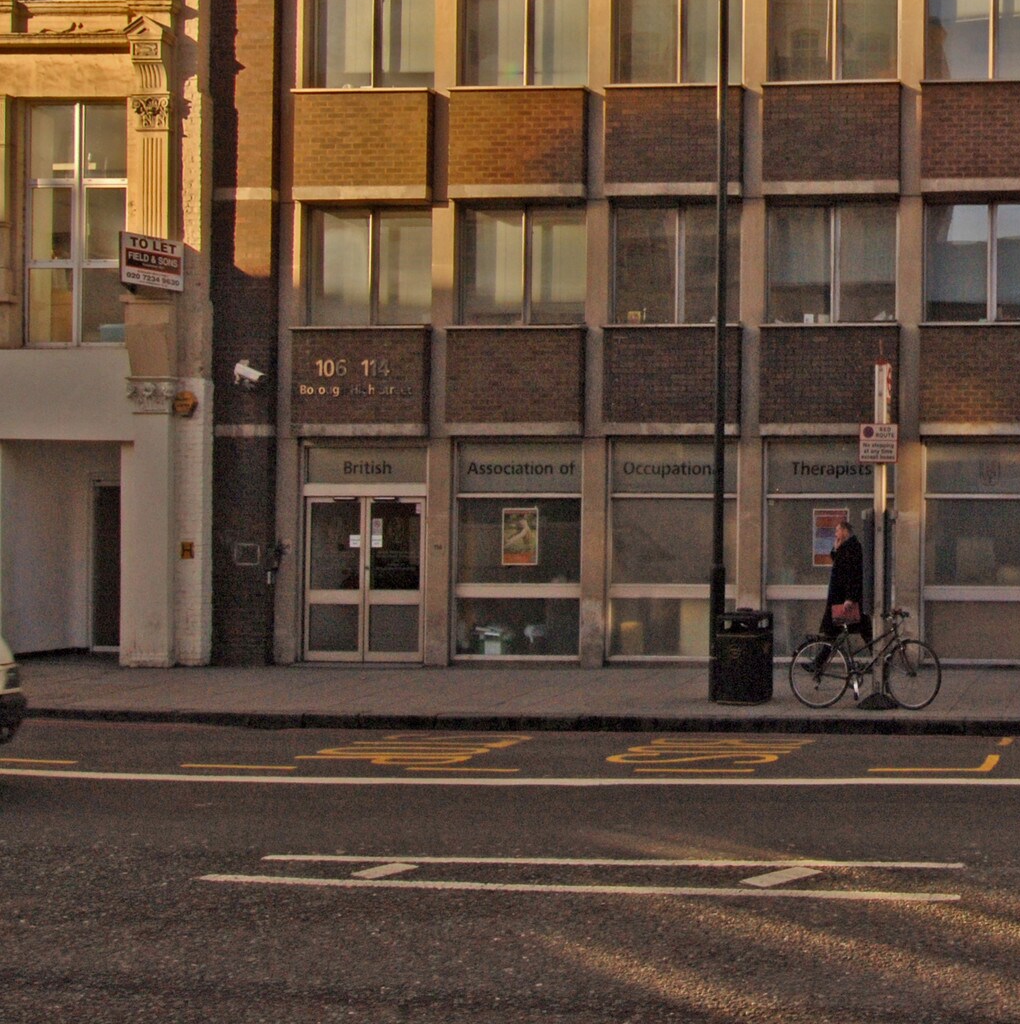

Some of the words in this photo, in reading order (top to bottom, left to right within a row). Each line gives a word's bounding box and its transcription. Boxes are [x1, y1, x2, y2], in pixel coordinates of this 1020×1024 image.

[129, 237, 149, 249] TO
[153, 241, 177, 254] LET
[128, 252, 149, 262] FIELD
[150, 256, 157, 264] &
[158, 256, 178, 268] SONS
[315, 359, 348, 377] 106
[361, 359, 391, 377] 114
[343, 460, 392, 475] British
[467, 462, 554, 475] Association
[559, 462, 576, 475] of
[792, 461, 873, 479] Therapists
